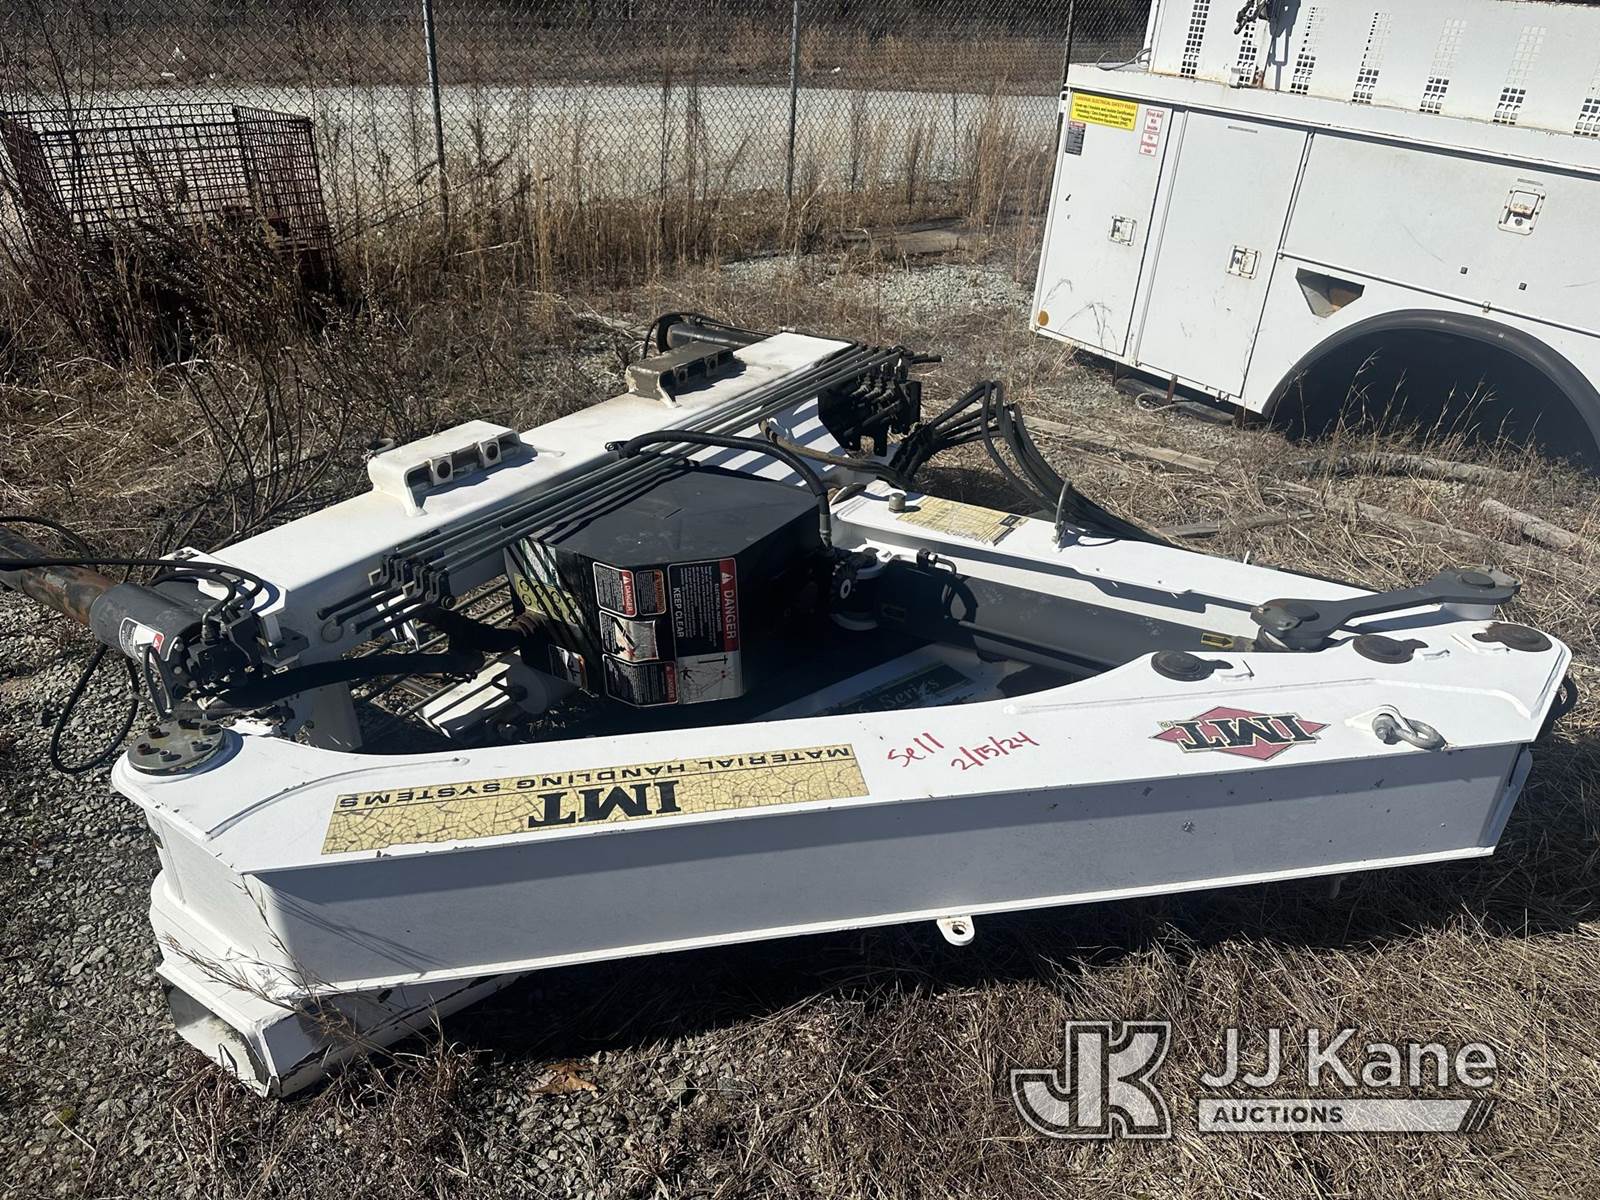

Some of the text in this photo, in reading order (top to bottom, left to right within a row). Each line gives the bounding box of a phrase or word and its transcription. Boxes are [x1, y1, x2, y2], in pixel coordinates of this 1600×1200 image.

[626, 585, 634, 613] DANGER
[673, 587, 685, 638] KEEP CLEAR
[723, 589, 737, 640] DANGER
[951, 731, 1040, 770] 2/15/24
[1174, 712, 1320, 752] IMT
[339, 747, 850, 808] MATERIAL HANDLING SYSTEMS
[528, 779, 682, 829] IMT
